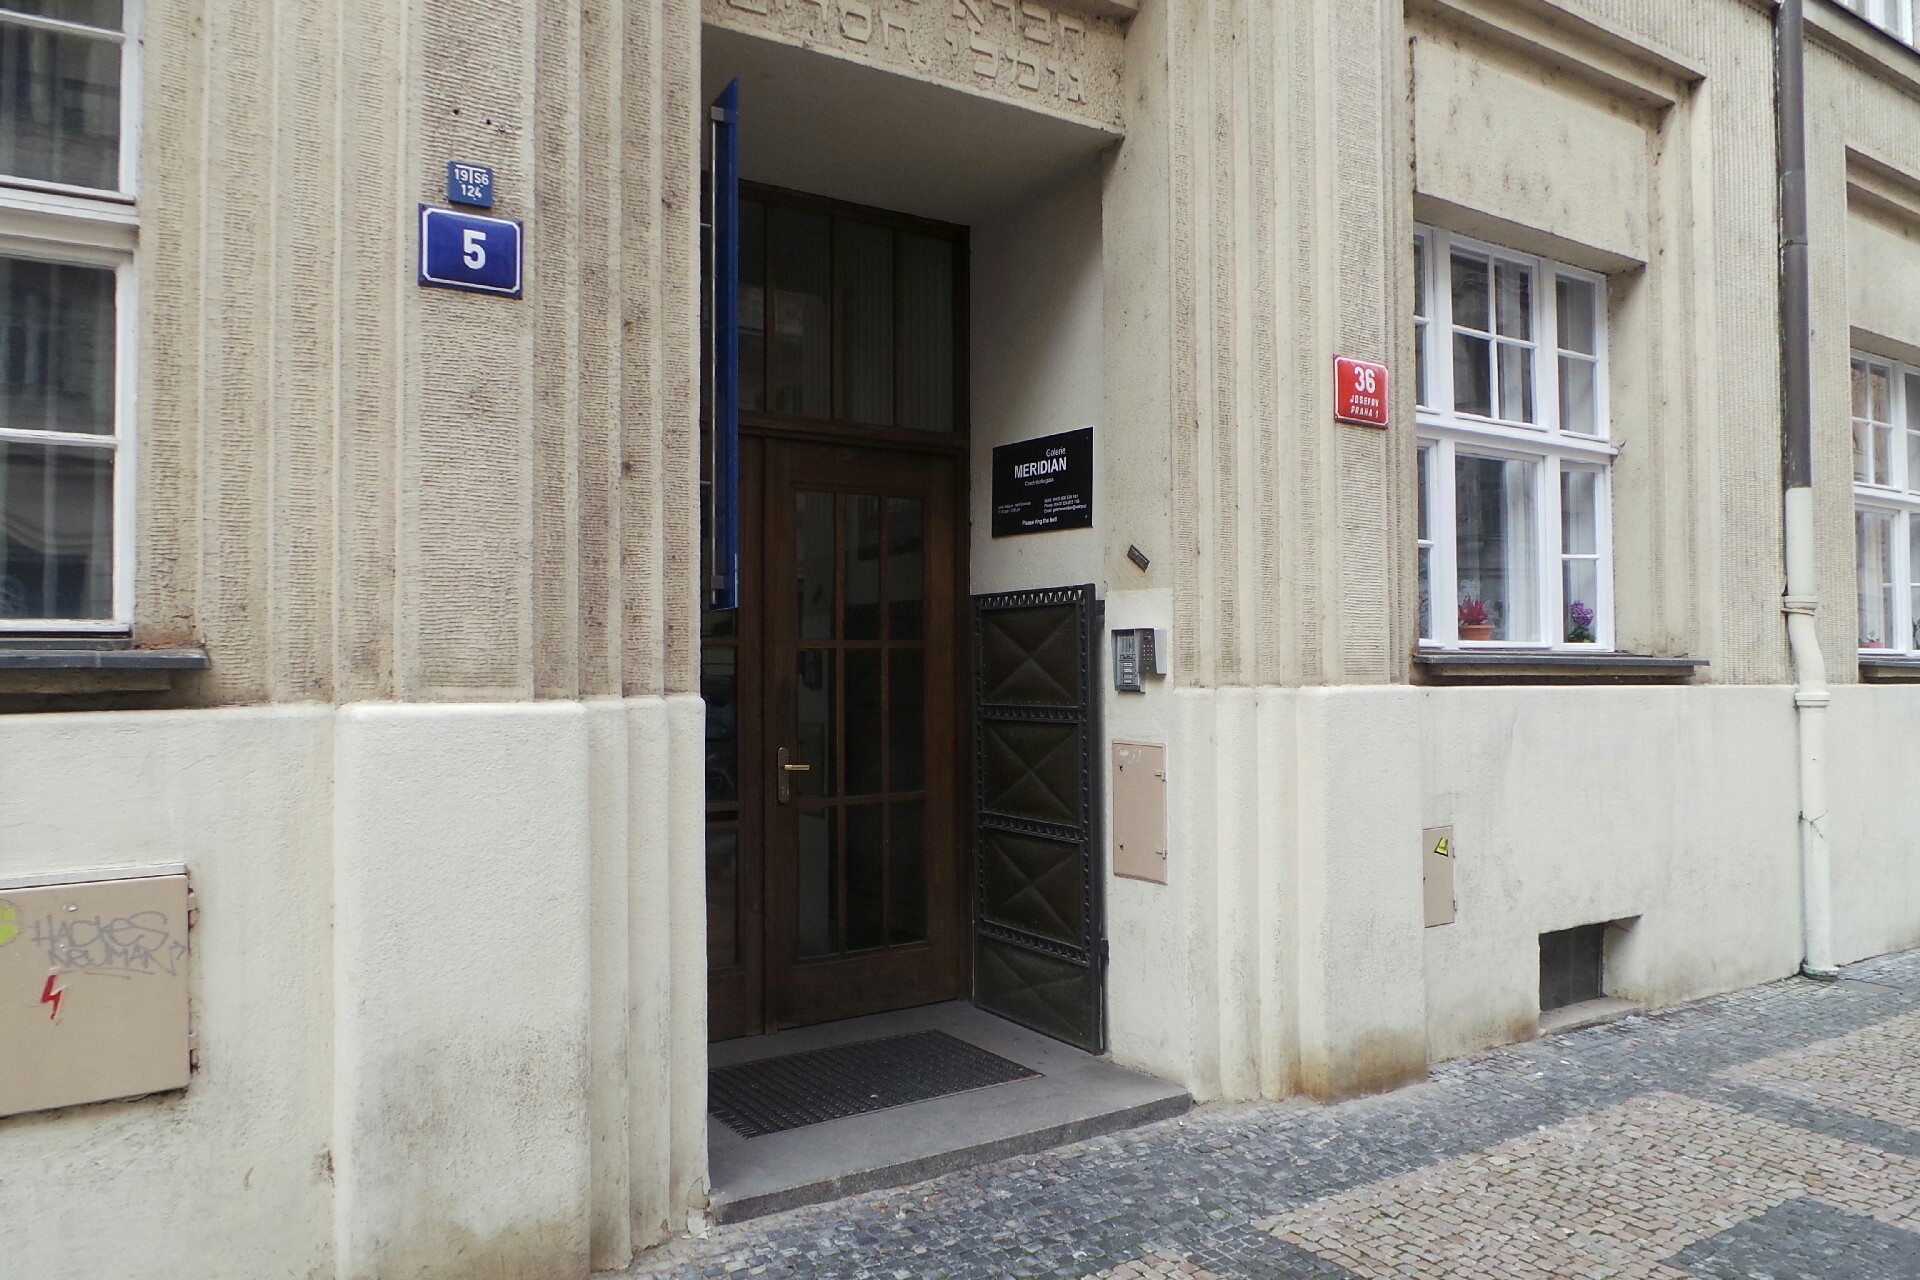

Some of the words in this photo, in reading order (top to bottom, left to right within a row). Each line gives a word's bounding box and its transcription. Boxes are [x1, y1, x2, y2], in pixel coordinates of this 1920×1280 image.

[463, 229, 486, 270] 5
[1354, 366, 1376, 394] 36
[1350, 394, 1379, 408] JOSEFOV
[1350, 405, 1373, 417] PRAHA
[1375, 409, 1379, 419] 1
[1045, 446, 1066, 458] Galerie
[1014, 456, 1067, 479] MERIDIAN
[1034, 518, 1043, 526] ring
